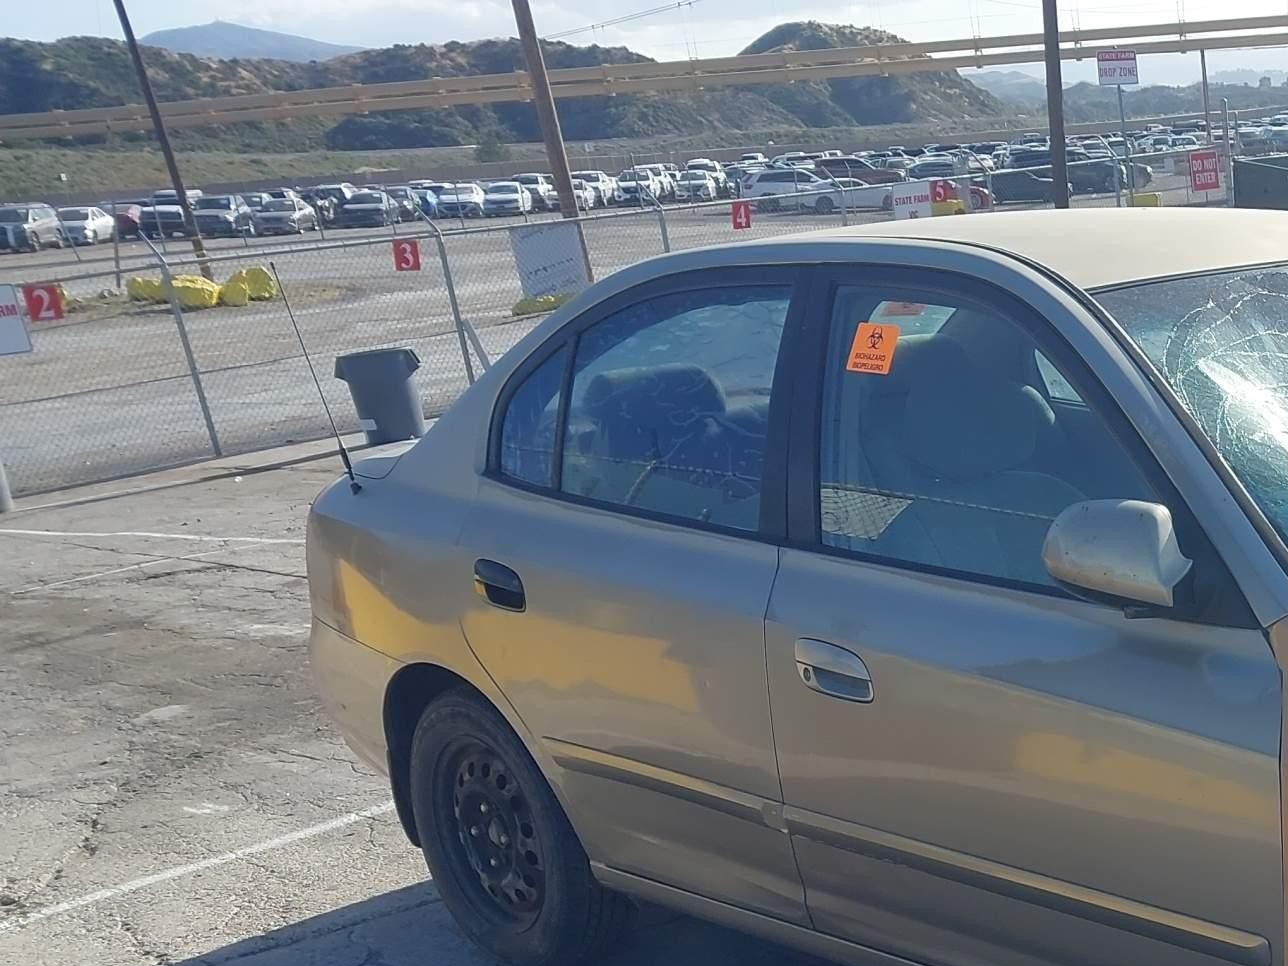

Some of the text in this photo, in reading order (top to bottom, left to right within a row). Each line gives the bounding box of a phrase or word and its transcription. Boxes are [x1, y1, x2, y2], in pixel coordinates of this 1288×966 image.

[1099, 66, 1137, 78] DROP ZONE
[1192, 157, 1216, 171] DO NOT
[1195, 171, 1216, 185] ENTER
[935, 180, 945, 201] 5
[895, 193, 930, 206] STATE FARM
[736, 204, 747, 227] 4
[400, 242, 414, 269] 3
[31, 288, 56, 318] 2
[854, 352, 886, 362] BIOHAZARD
